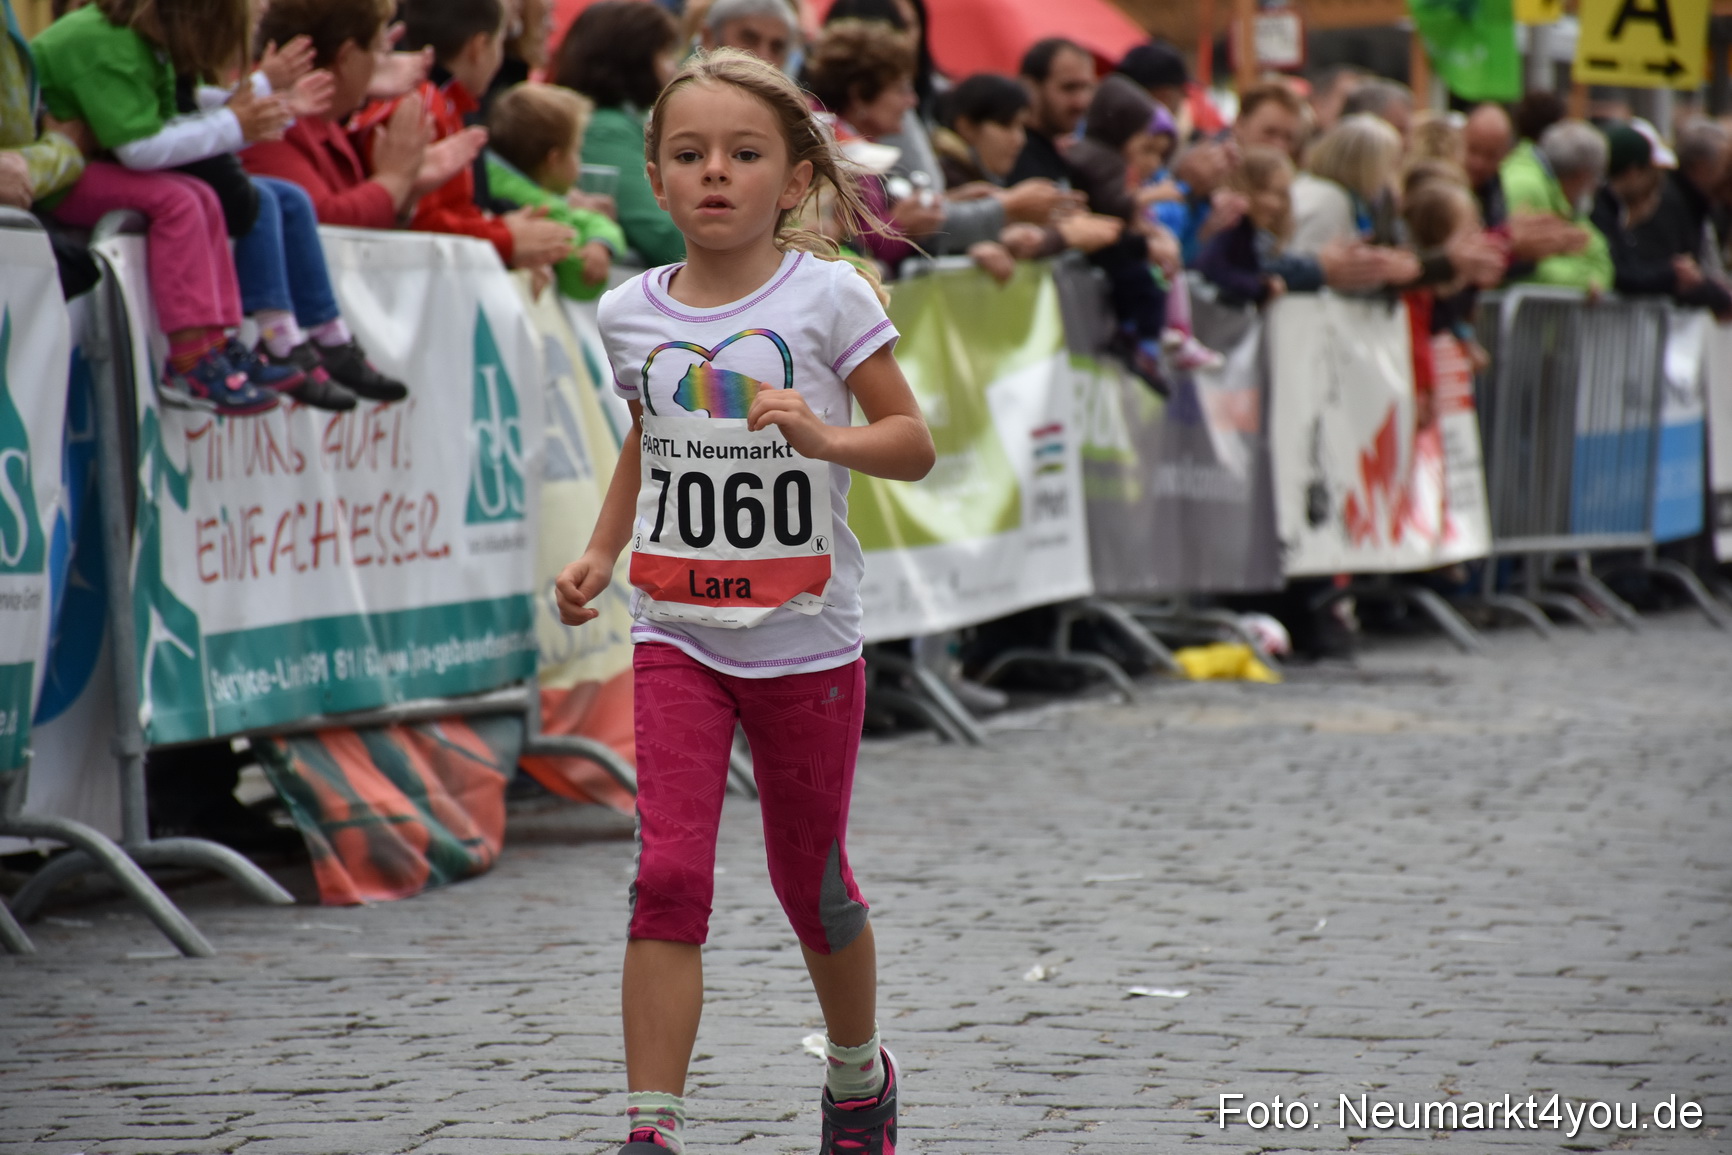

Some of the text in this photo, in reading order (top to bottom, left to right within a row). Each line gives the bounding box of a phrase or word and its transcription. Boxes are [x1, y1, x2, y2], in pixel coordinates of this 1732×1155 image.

[1608, 0, 1675, 43] A
[642, 434, 793, 459] PARTL Neumarkt
[649, 469, 813, 549] 7060
[634, 535, 642, 549] 3
[816, 538, 824, 551] K
[689, 569, 752, 600] Lara
